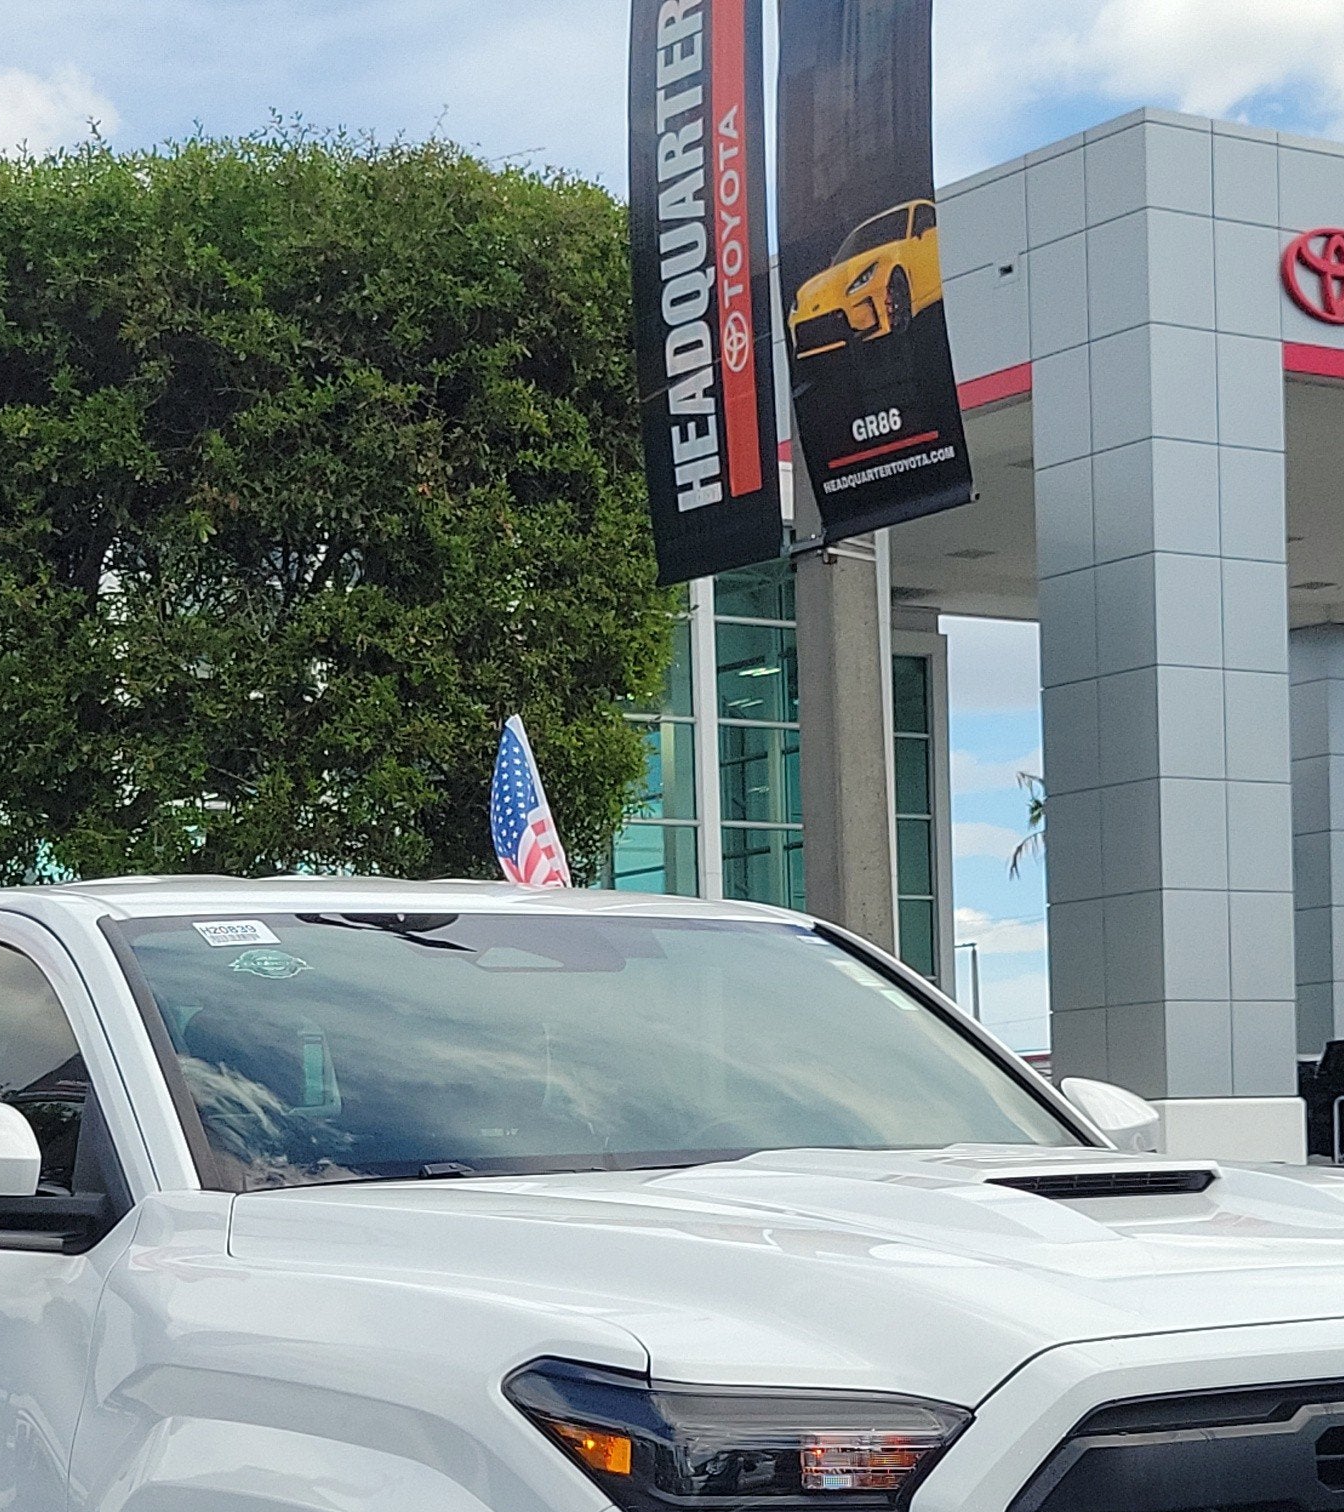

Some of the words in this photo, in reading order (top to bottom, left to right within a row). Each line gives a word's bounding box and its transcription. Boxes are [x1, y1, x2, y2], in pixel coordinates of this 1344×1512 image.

[656, 0, 722, 512] HEADQUARTER
[718, 105, 750, 302] TOYOTA
[822, 446, 955, 494] HEADQUARTERTOYOTA.COM
[852, 407, 902, 442] GR86
